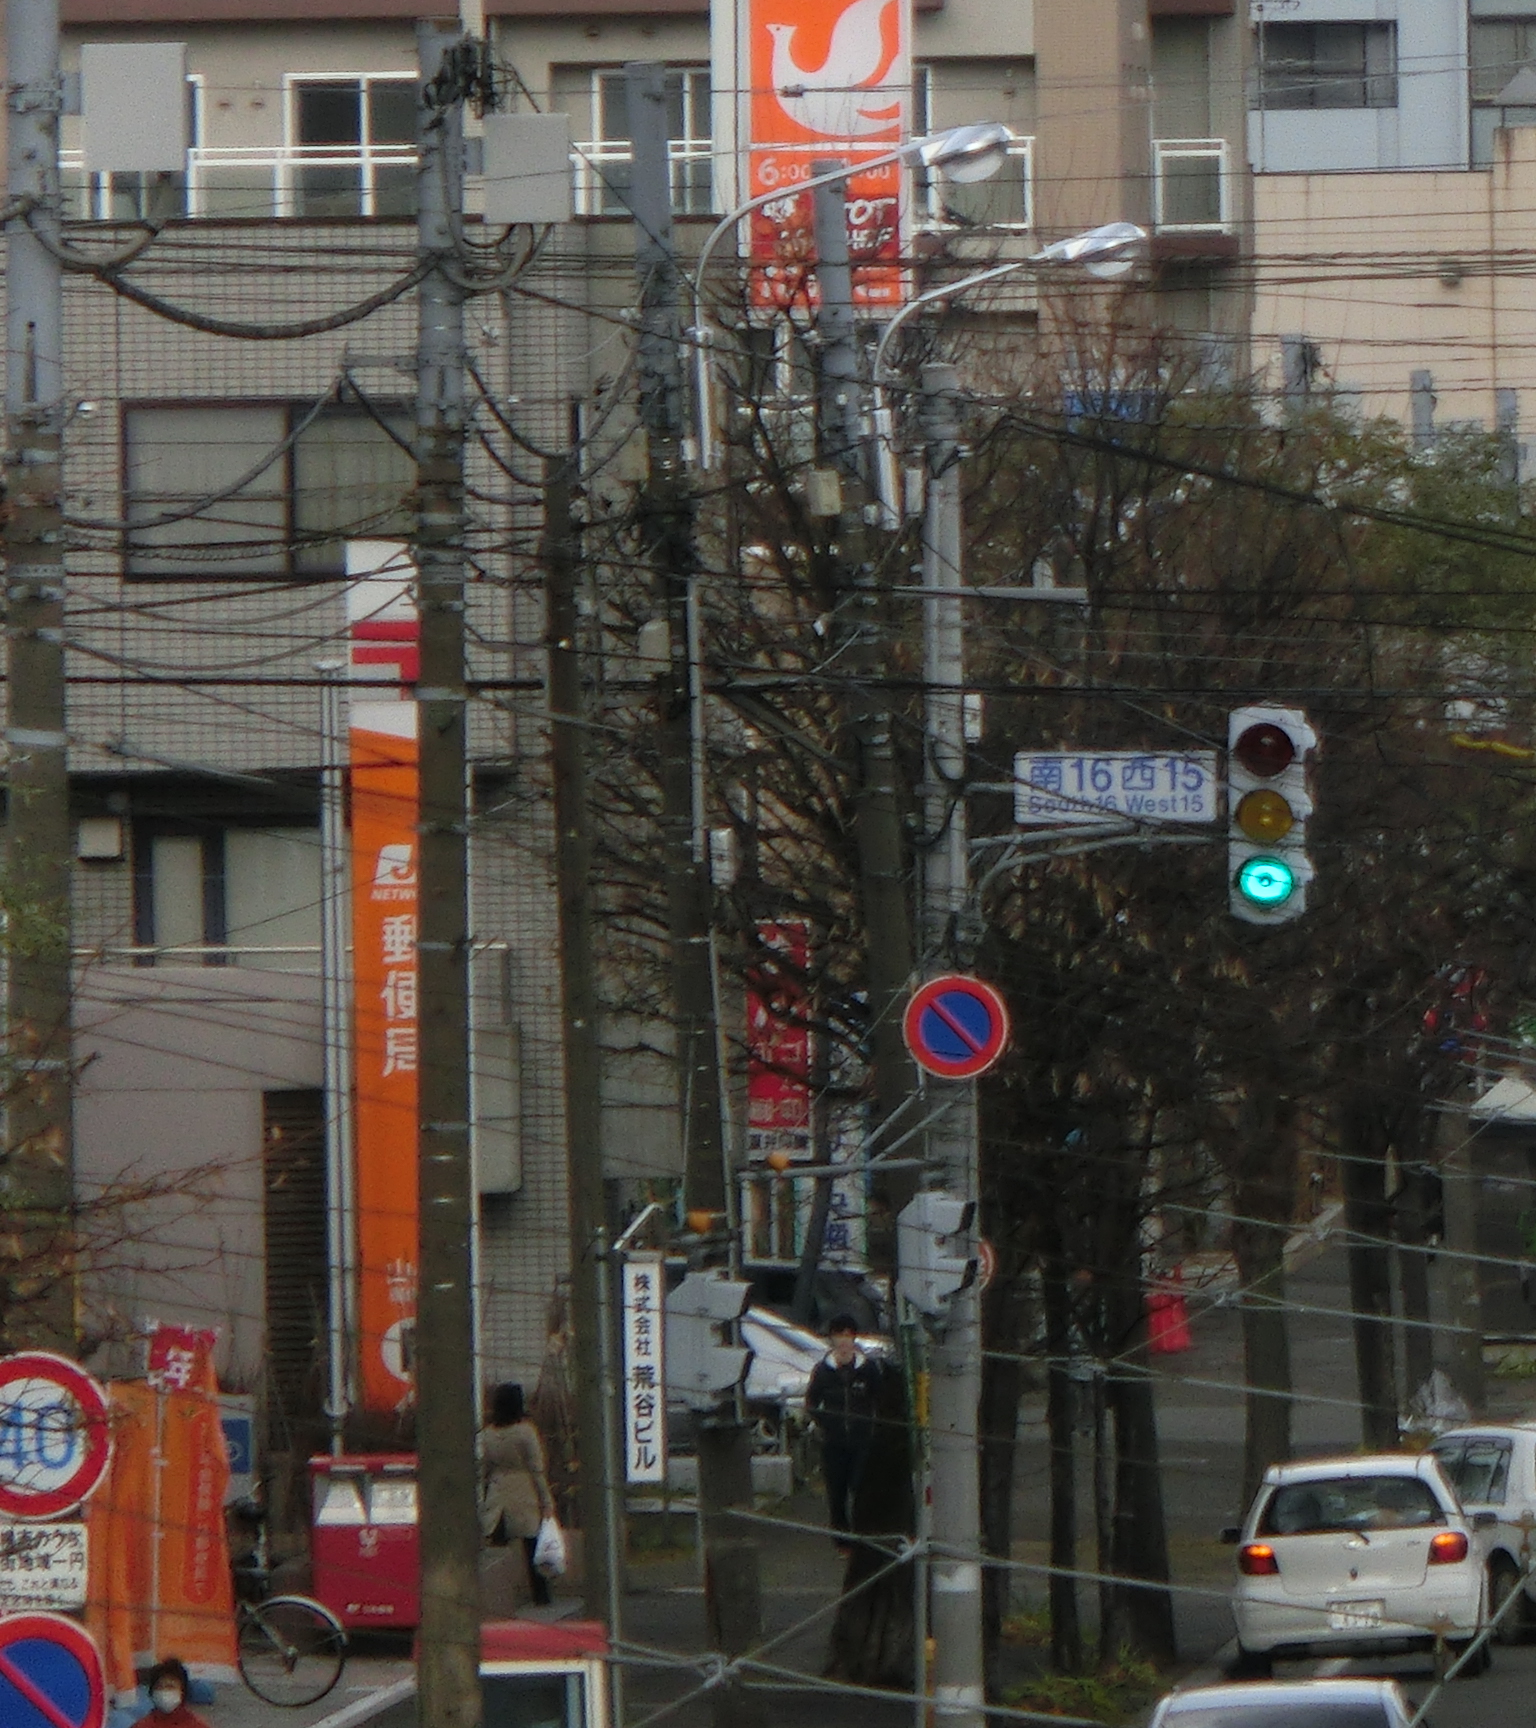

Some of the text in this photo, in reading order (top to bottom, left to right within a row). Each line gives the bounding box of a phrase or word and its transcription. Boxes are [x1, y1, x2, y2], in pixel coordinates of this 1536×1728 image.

[1030, 757, 1204, 793] 南16西15
[1126, 794, 1204, 813] West15
[633, 1274, 651, 1356] 株式会社
